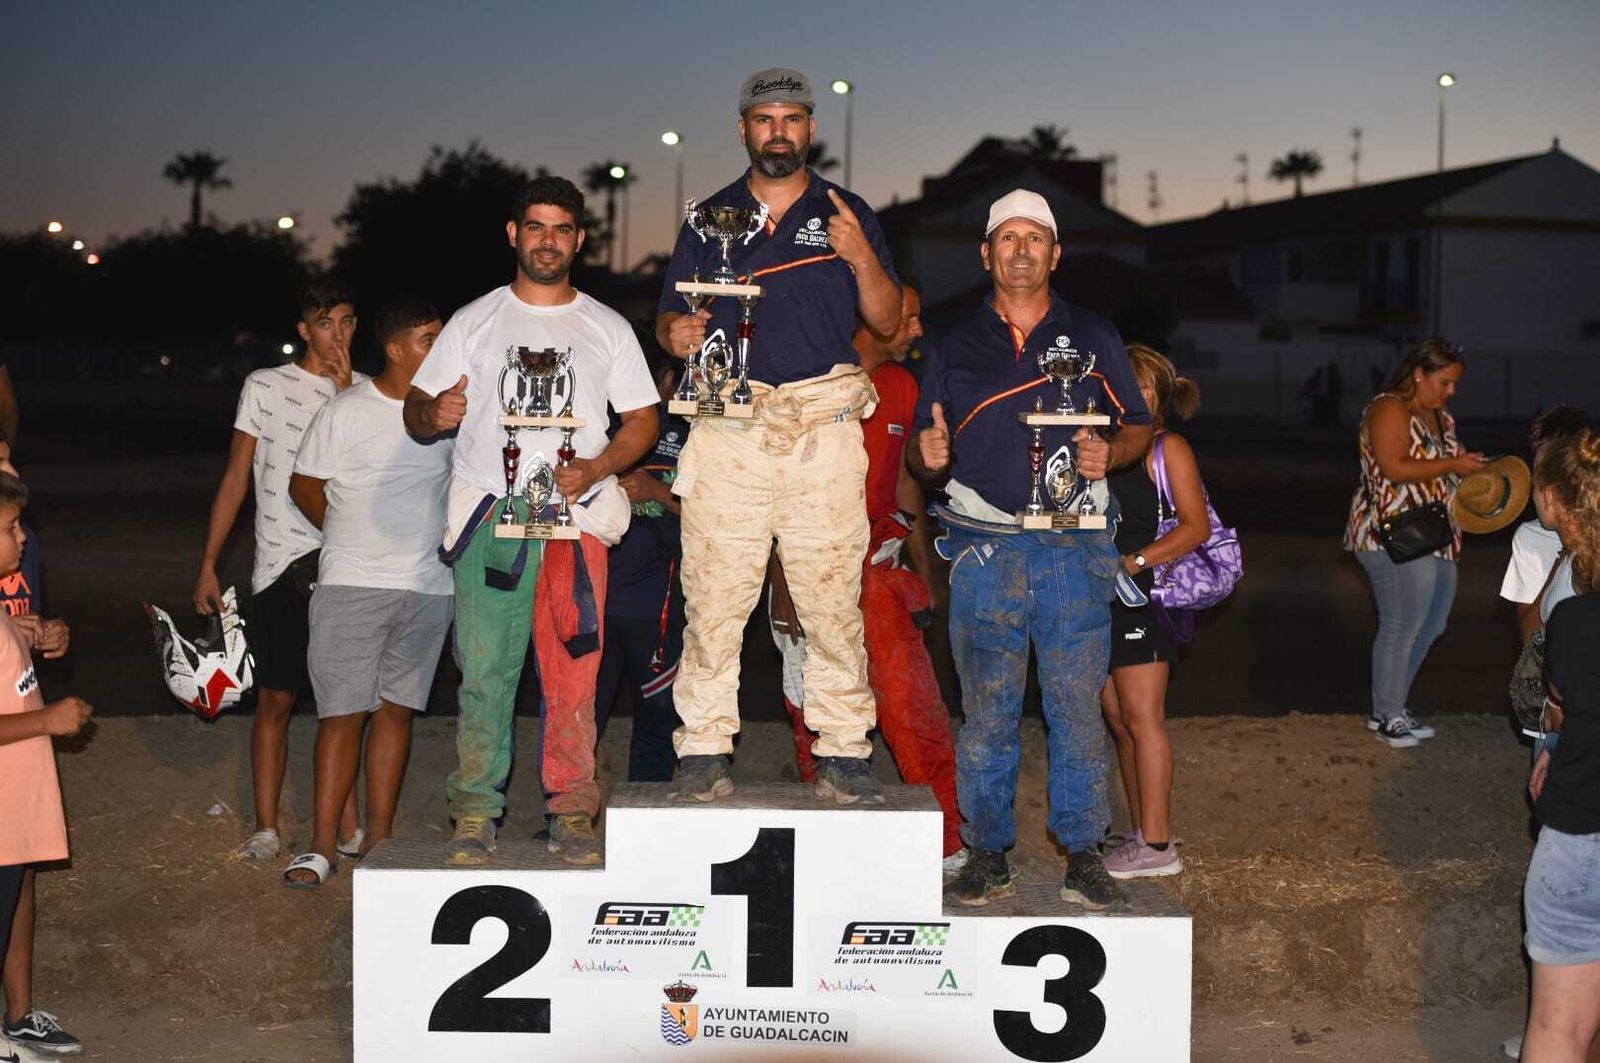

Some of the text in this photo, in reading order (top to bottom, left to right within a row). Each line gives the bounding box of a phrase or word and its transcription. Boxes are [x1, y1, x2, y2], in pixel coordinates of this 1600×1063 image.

[751, 76, 803, 97] Brooklyn
[711, 828, 795, 988] 1
[588, 937, 696, 946] de automovilismo
[650, 928, 697, 937] andaluza
[428, 885, 552, 1034] 2
[852, 957, 942, 965] automovilismo
[896, 948, 942, 956] andaluza
[993, 924, 1107, 1063] 3
[703, 1007, 830, 1025] AYUNTAMIENTO
[703, 1025, 848, 1043] DE GUADALCACIN
